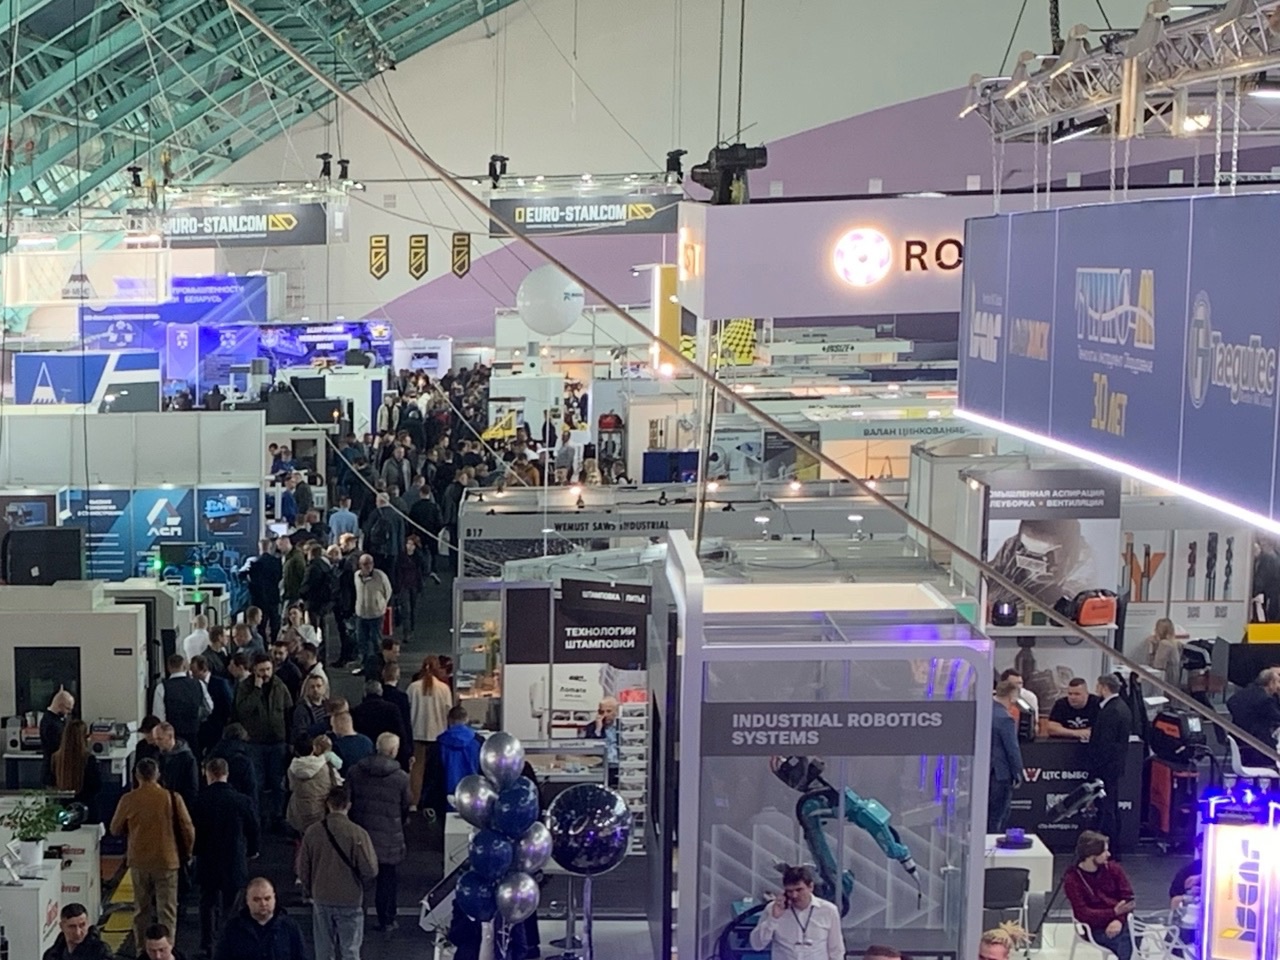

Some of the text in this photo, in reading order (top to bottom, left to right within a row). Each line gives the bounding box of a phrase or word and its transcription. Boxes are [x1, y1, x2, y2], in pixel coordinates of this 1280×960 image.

[526, 204, 626, 223] EURO-STAN.COM
[554, 522, 589, 532] WEMUST
[564, 626, 636, 637] ТЕХНОЛОГИИ
[564, 639, 635, 649] ШТАМПОВКИ
[732, 712, 942, 728] INDUSTRIAL ROBOTICS
[731, 730, 819, 745] SYSTEMS
